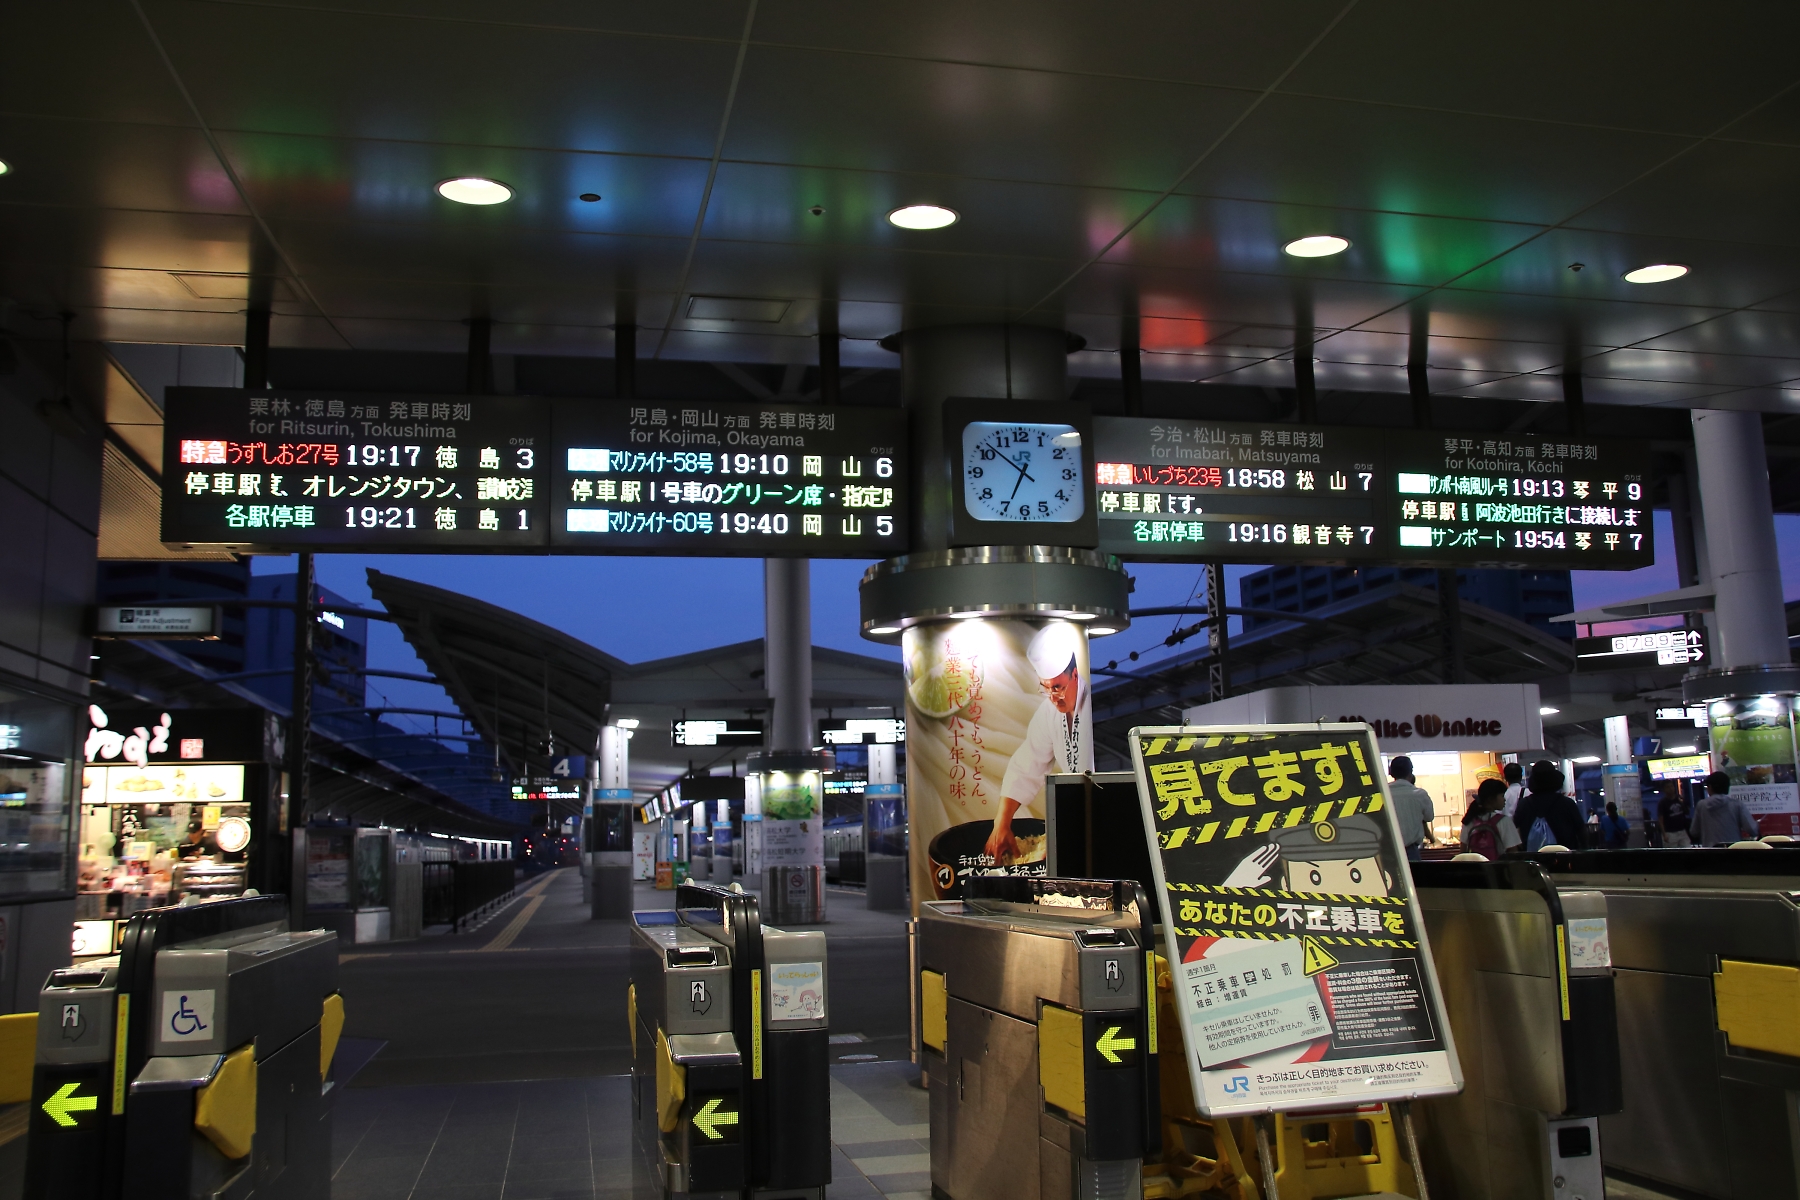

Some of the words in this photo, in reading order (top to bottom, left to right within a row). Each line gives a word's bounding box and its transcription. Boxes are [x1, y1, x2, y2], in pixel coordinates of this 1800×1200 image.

[249, 399, 346, 418] 栗林・徳島
[351, 406, 379, 419] 方面
[390, 401, 471, 421] 発車時刻
[630, 408, 718, 428] 児島・岡山
[724, 415, 750, 428] 方面
[760, 411, 835, 431] 発車時刻
[250, 420, 274, 435] for
[281, 420, 355, 438] Ritsurin,
[361, 422, 456, 439] Tokushima
[630, 430, 655, 444] for
[659, 430, 722, 447] Kojima,
[727, 431, 805, 448] Okayama
[1012, 432, 1029, 443] 12
[1150, 426, 1226, 444] 今治・松山
[1230, 433, 1252, 445] 方面
[1260, 431, 1323, 449] 発車時刻
[509, 437, 534, 446] のりば
[996, 437, 1010, 448] 11
[1037, 436, 1044, 447] 1
[1444, 439, 1512, 456] 琴平・高知
[1515, 446, 1535, 457] 方面
[1542, 443, 1597, 460] 発車時刻
[181, 440, 227, 464] 特急
[347, 444, 421, 468] 19:17
[516, 448, 534, 469] 3
[980, 449, 996, 460] 10
[1012, 451, 1031, 462] JR
[1053, 448, 1063, 460] 2
[1150, 445, 1169, 458] for
[1175, 446, 1234, 462] Imabari,
[1238, 449, 1320, 465] Matsuyama
[720, 454, 789, 476] 19:10
[876, 457, 893, 478] 6
[972, 467, 983, 478] 9
[1062, 469, 1072, 480] 3
[1354, 463, 1374, 471] のりば
[1445, 457, 1463, 470] for
[1467, 458, 1524, 474] Kotohira,
[1528, 460, 1563, 474] Kōchi
[184, 471, 261, 497] 停車駅
[1097, 462, 1134, 485] 特急
[1227, 468, 1285, 488] 18:58
[1358, 472, 1372, 491] 7
[571, 478, 641, 503] 停車駅
[982, 488, 993, 499] 8
[1055, 489, 1065, 500] 4
[1512, 478, 1564, 498] 19:13
[1628, 483, 1641, 500] 9
[1001, 501, 1011, 512] 7
[1019, 505, 1030, 516] 6
[1038, 501, 1049, 513] 5
[1100, 491, 1161, 513] 停車駅
[1401, 499, 1456, 521] 停車駅
[226, 504, 315, 529] 各駅停車
[346, 506, 416, 529] 19:21
[518, 509, 529, 530] 1
[720, 513, 789, 536] 19:40
[877, 516, 893, 536] 5
[1134, 521, 1205, 542] 各駅停車
[1228, 523, 1287, 543] 19:16
[1293, 524, 1354, 545] 観音寺
[1360, 526, 1374, 545] 7
[1431, 528, 1506, 548] サンポート
[1514, 530, 1566, 549] 19:54
[1629, 533, 1643, 551] 7
[1615, 639, 1624, 650] 6
[1630, 637, 1639, 648] 7
[1644, 636, 1654, 647] 8
[1659, 634, 1669, 646] 9
[1339, 715, 1413, 738] llie
[1414, 714, 1502, 738] Winkie
[1650, 738, 1661, 754] 7
[553, 758, 570, 777] 4
[1149, 740, 1374, 821] 見てます!
[606, 789, 619, 798] JR
[1178, 898, 1405, 935] あなたの不正乗車を
[1191, 975, 1240, 998] 不正乗車
[1308, 1005, 1321, 1022] 罪
[1223, 1075, 1251, 1094] JR
